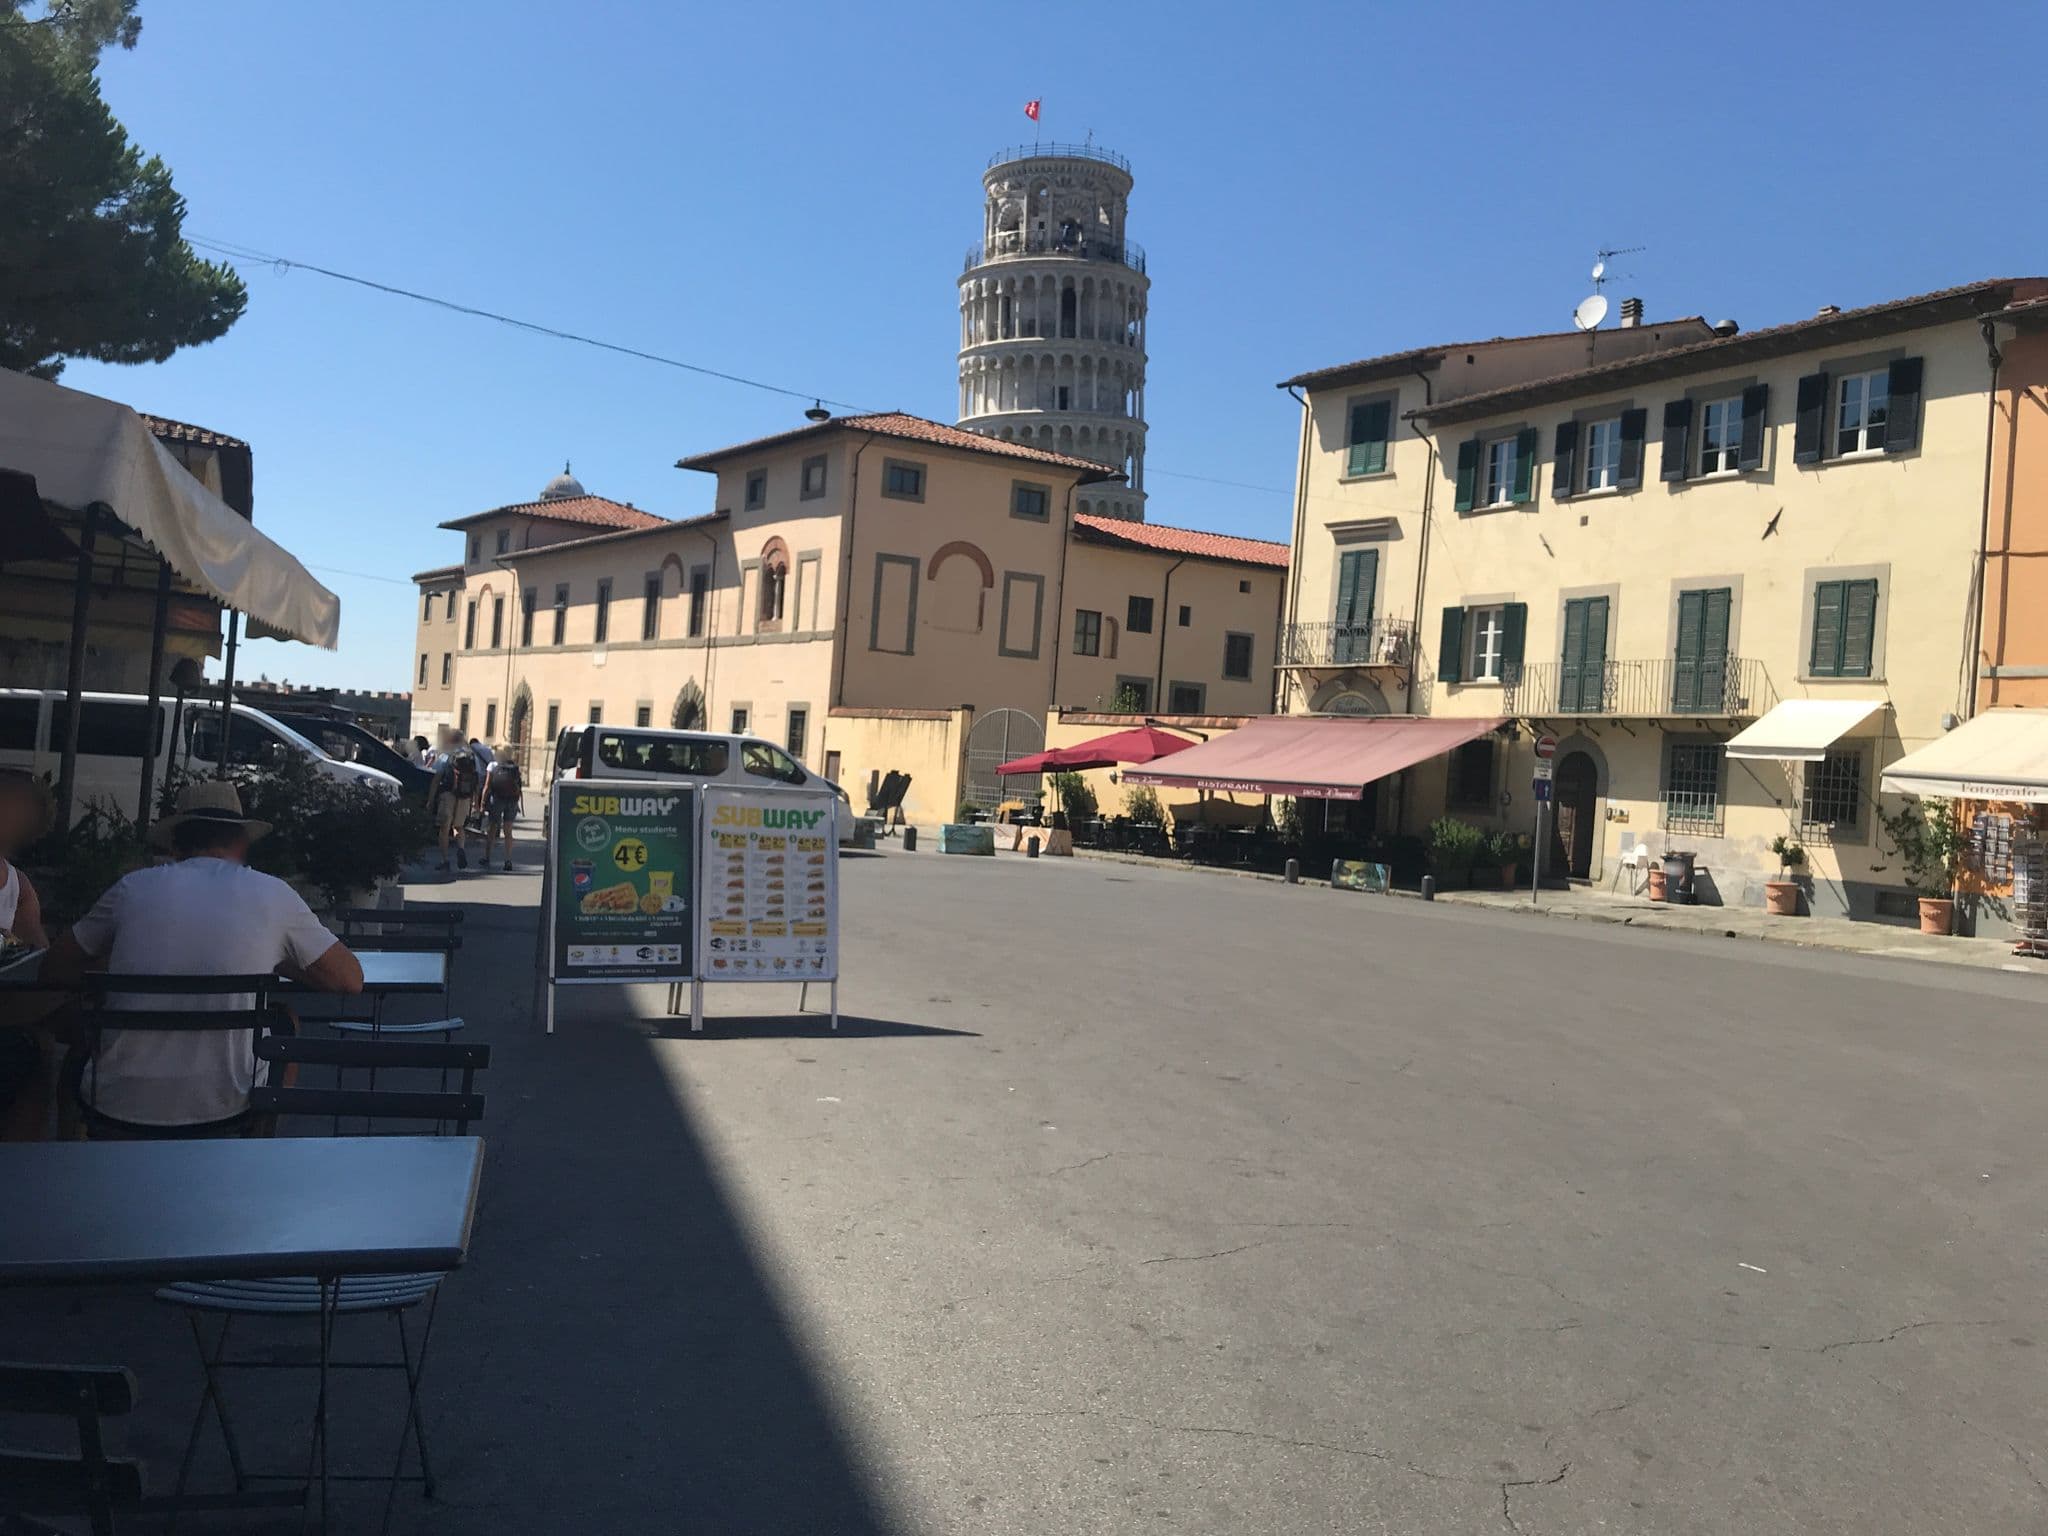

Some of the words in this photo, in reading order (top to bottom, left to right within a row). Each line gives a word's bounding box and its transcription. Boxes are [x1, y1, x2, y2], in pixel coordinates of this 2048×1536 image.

[1198, 779, 1262, 791] RISTORANTE
[1961, 784, 2037, 797] Fotografo
[571, 796, 680, 816] SUBWAY
[712, 805, 826, 829] SUBWAY
